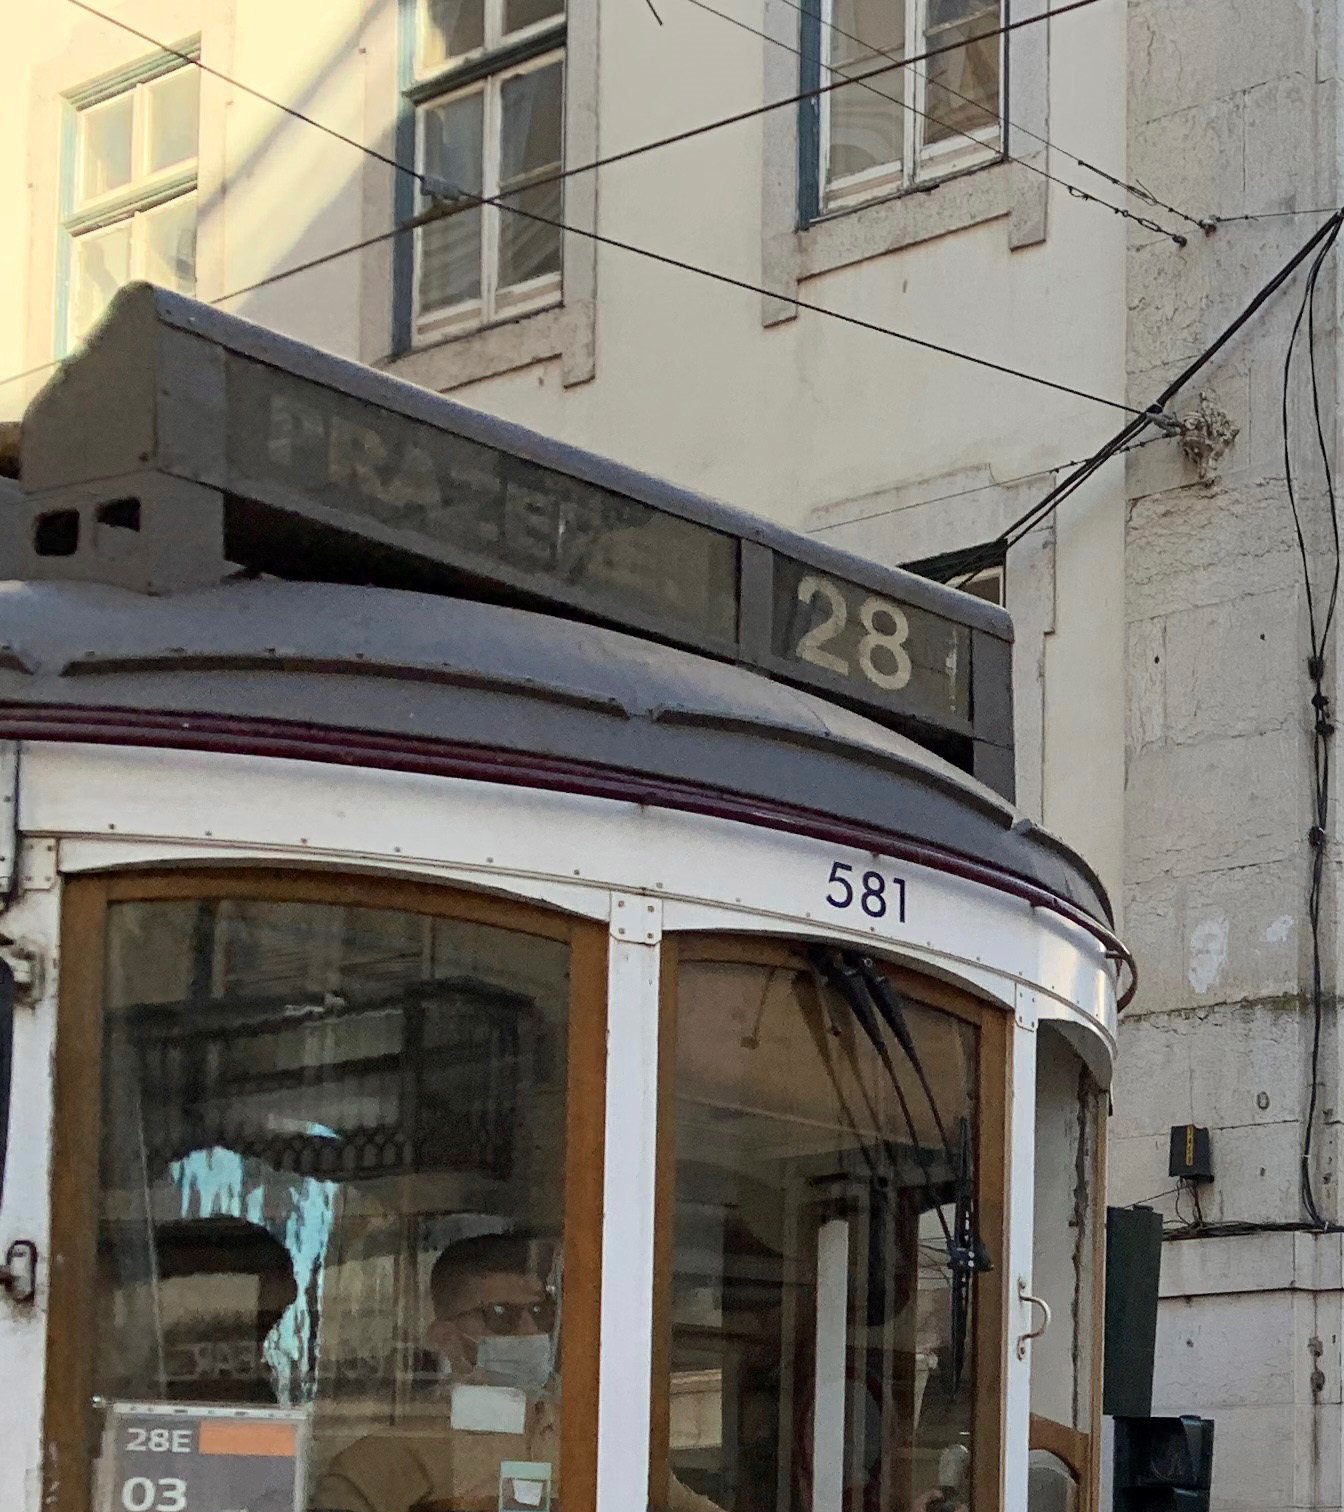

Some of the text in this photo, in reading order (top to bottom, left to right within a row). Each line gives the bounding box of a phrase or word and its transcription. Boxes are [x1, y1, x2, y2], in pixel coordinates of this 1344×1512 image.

[796, 575, 912, 691] 28
[825, 861, 906, 923] 581
[124, 1427, 193, 1454] 28E
